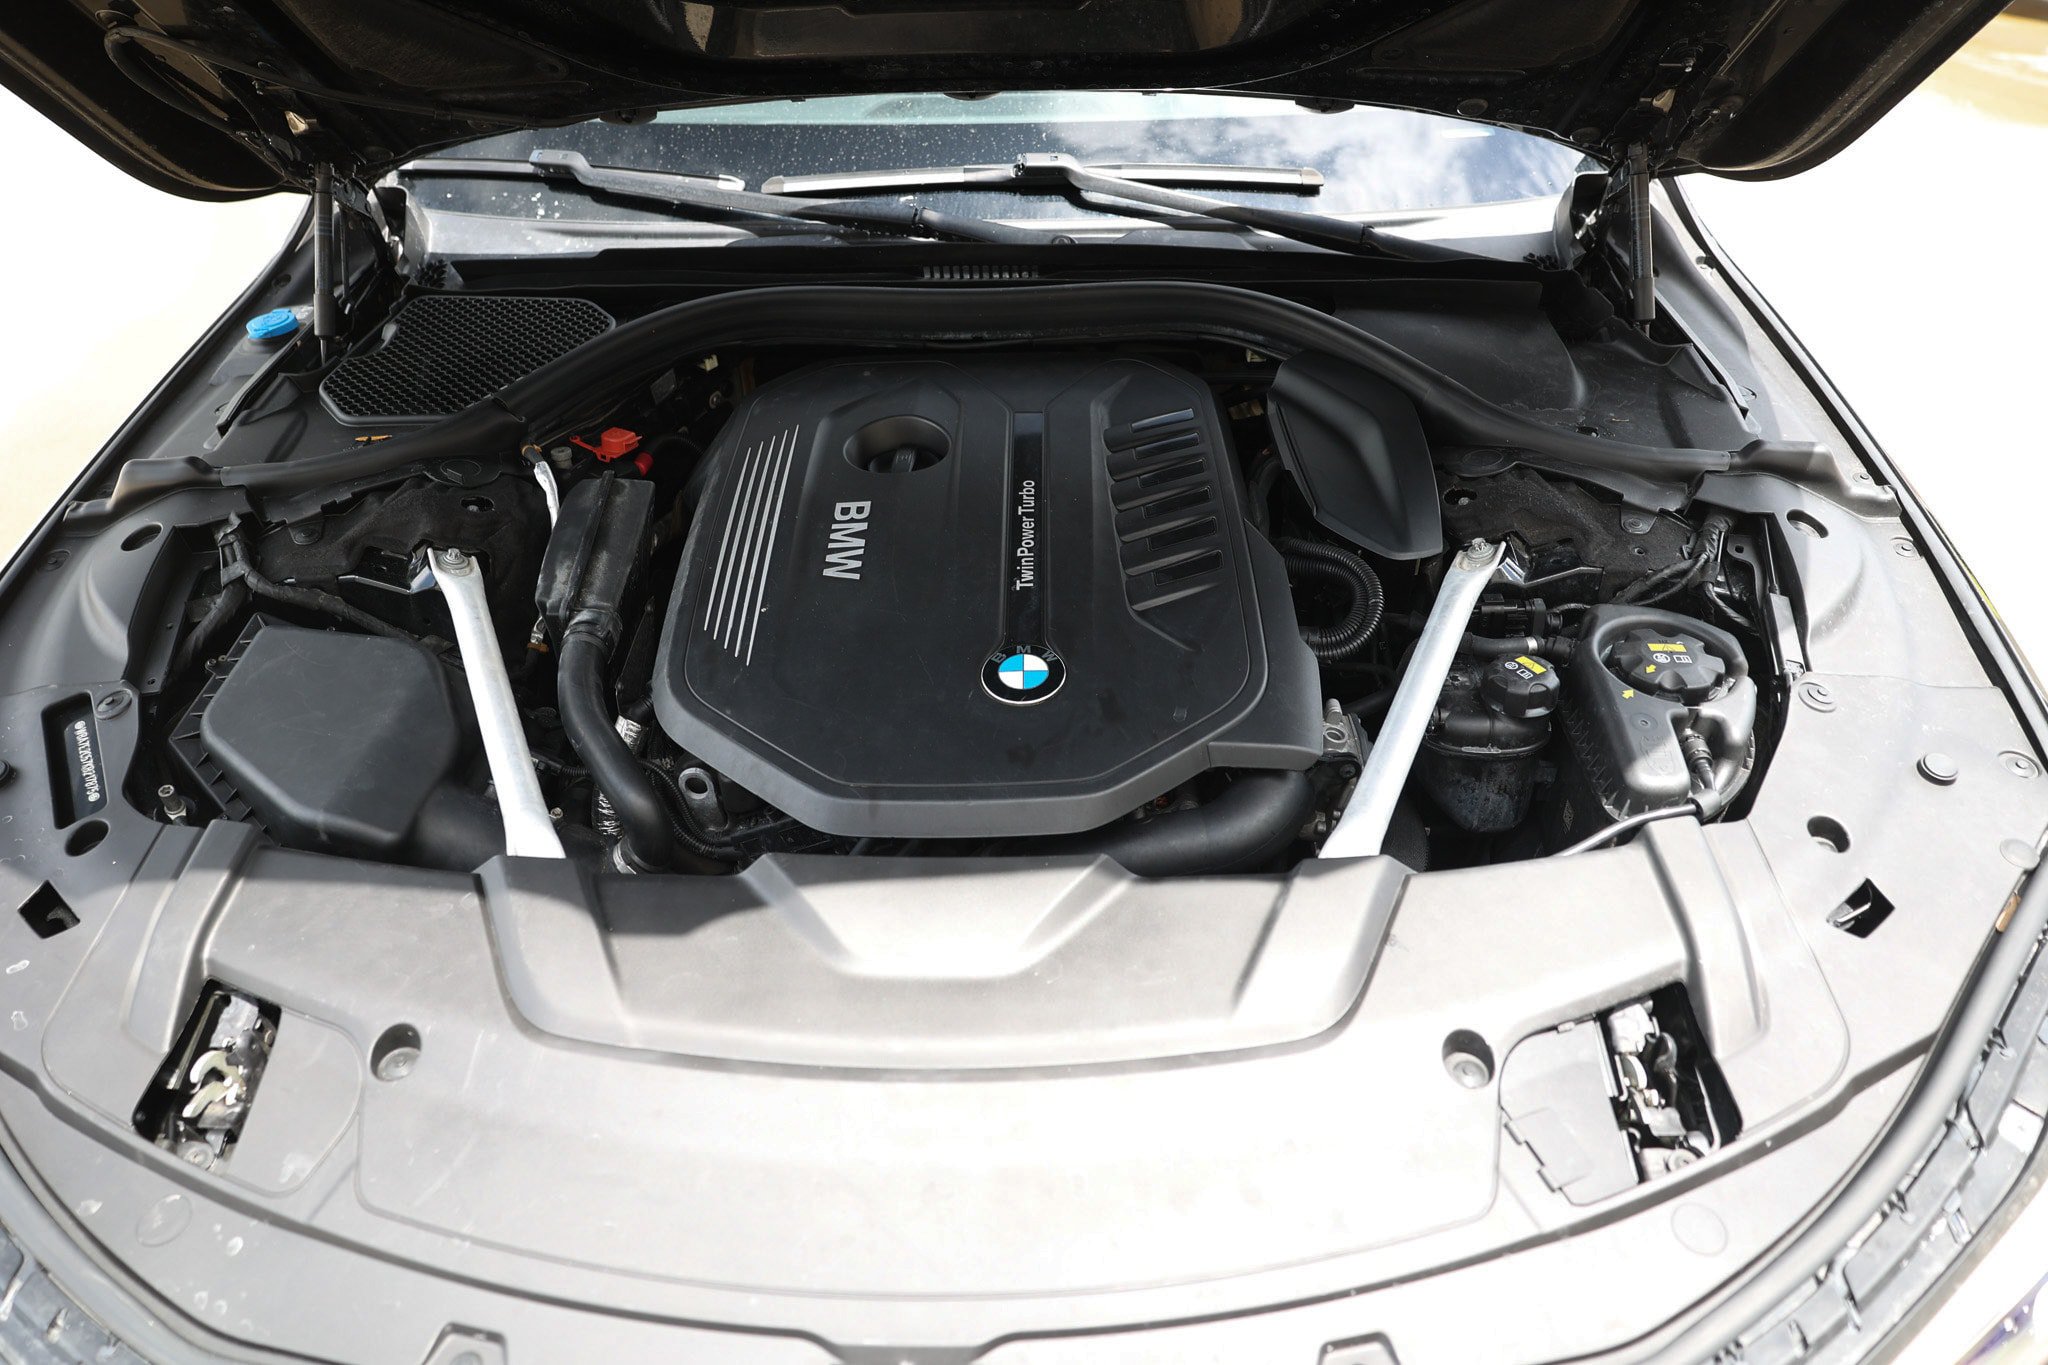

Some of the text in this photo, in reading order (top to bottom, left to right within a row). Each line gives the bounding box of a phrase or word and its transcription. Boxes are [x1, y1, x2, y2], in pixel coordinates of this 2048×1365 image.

[822, 500, 872, 580] BMW
[1015, 480, 1035, 591] TwinPower Turbo
[990, 645, 1059, 664] BMW
